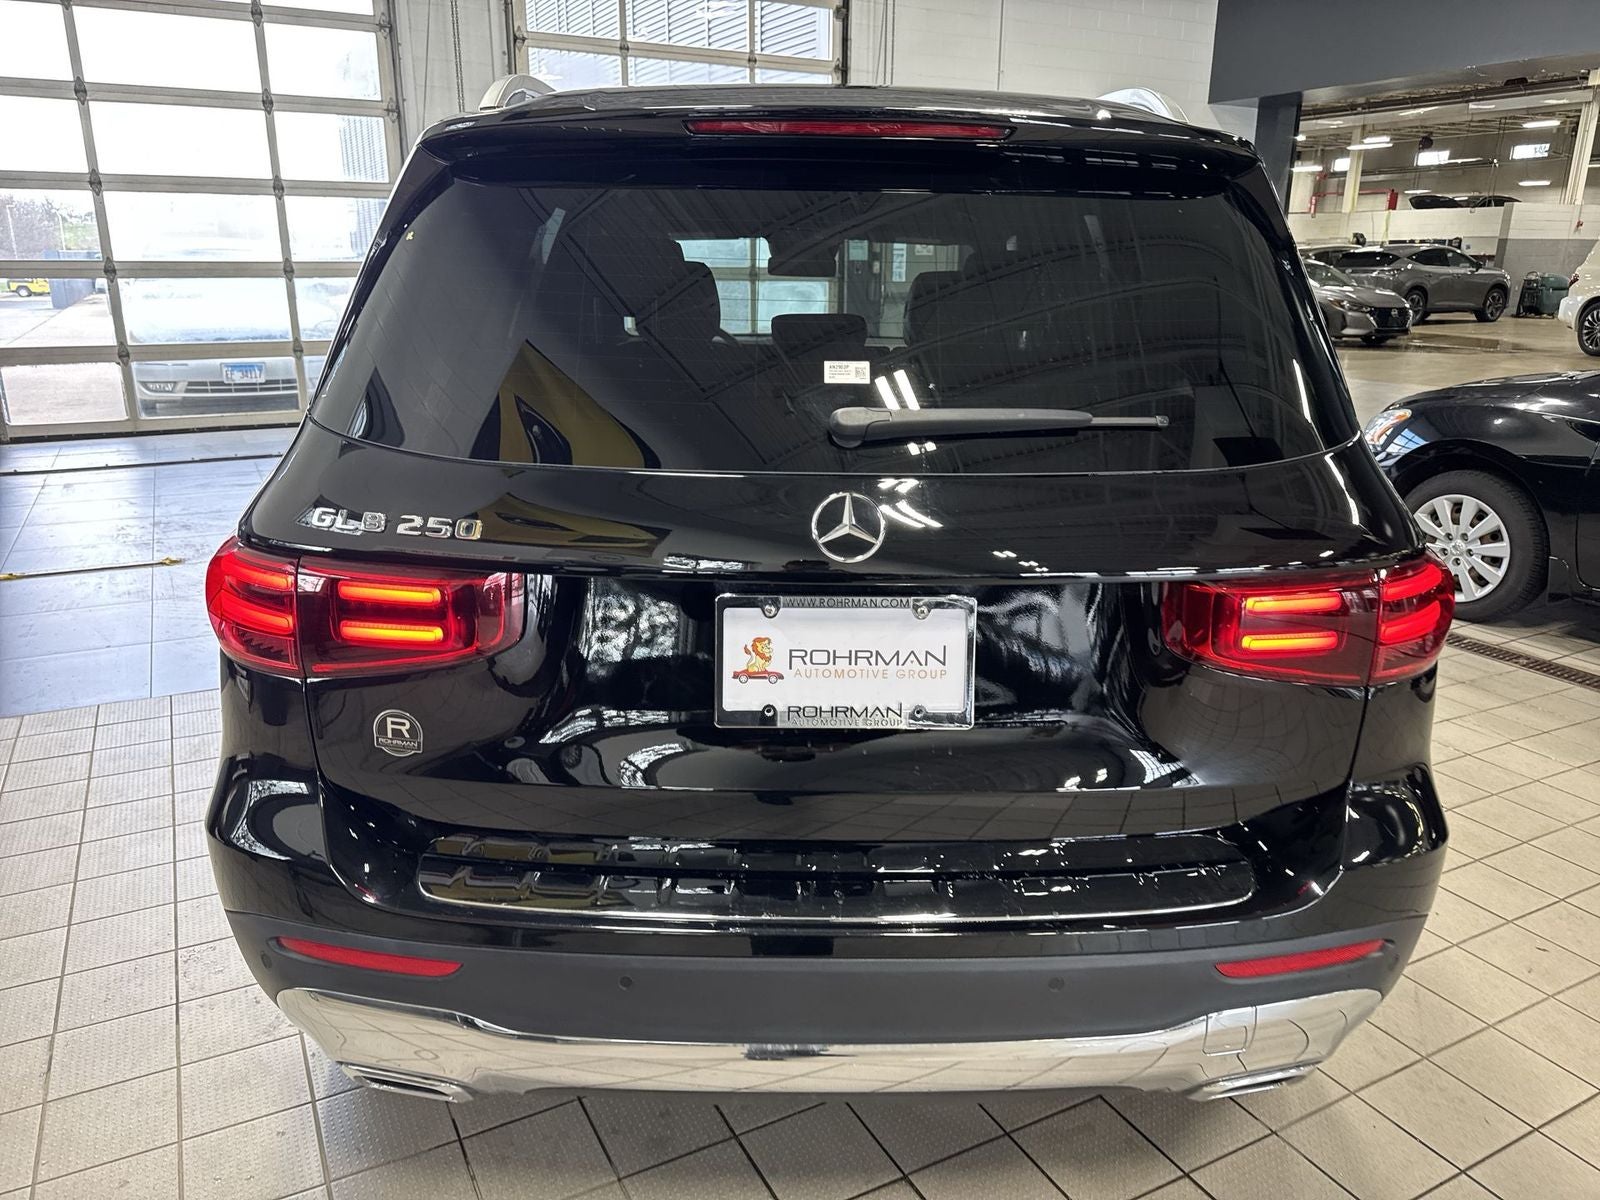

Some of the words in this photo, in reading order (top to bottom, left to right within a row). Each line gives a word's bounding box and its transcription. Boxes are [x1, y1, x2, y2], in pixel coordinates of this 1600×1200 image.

[311, 506, 387, 533] GLB
[396, 514, 483, 541] 250
[785, 598, 911, 608] WWW.ROHRMAN.COM
[788, 645, 947, 670] ROHRMAN
[794, 668, 889, 680] AUTOMOTIVE
[896, 669, 948, 680] GROUP
[787, 702, 903, 721] ROHRMAN
[386, 717, 411, 739] R
[792, 718, 860, 727] AUTOMOTIVE
[865, 718, 903, 727] GROUP
